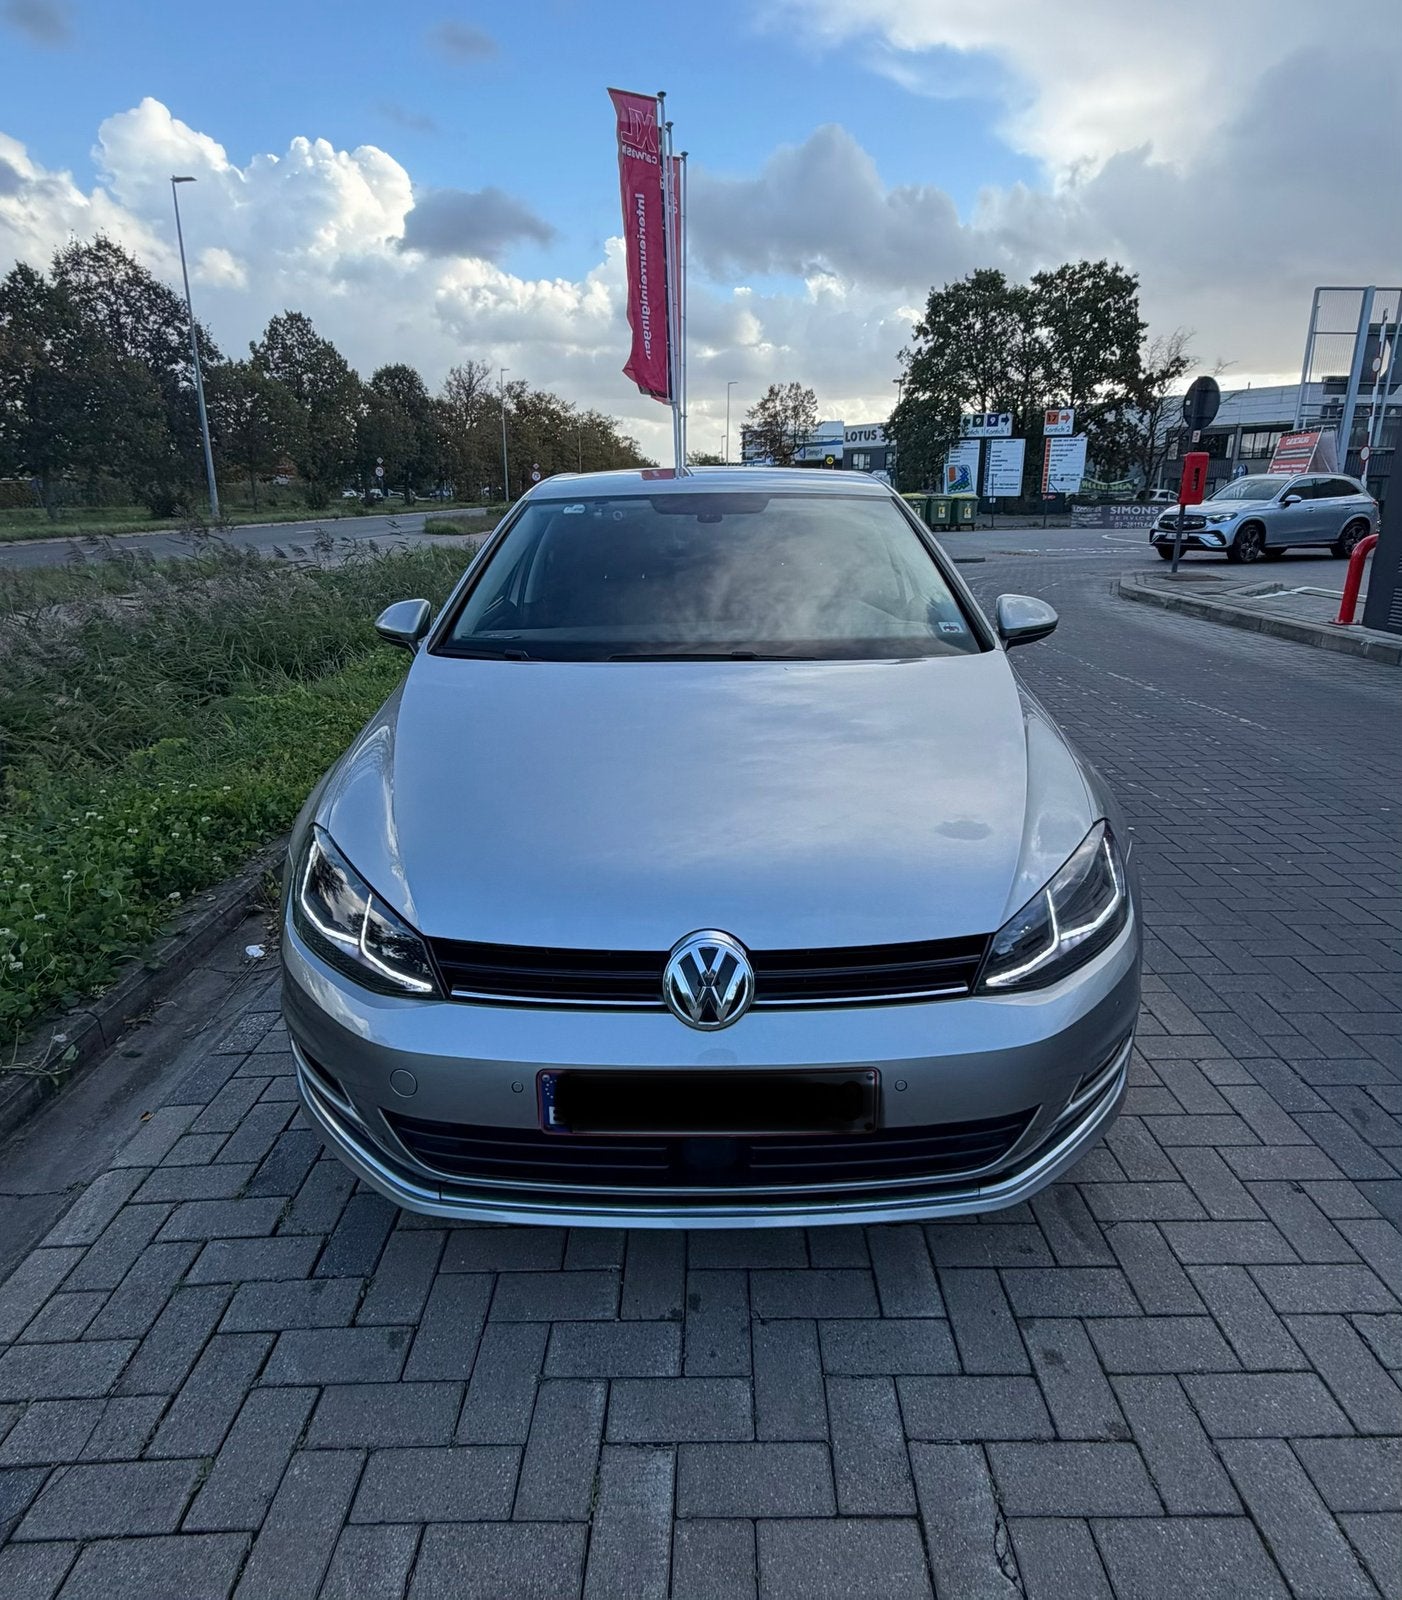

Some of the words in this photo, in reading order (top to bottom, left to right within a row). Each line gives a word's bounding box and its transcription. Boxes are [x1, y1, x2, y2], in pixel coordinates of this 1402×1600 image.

[975, 417, 982, 425] 9
[990, 416, 996, 425] 9
[1066, 425, 1071, 433] 2
[845, 430, 877, 442] LOTUS
[1110, 506, 1159, 515] SIMONS
